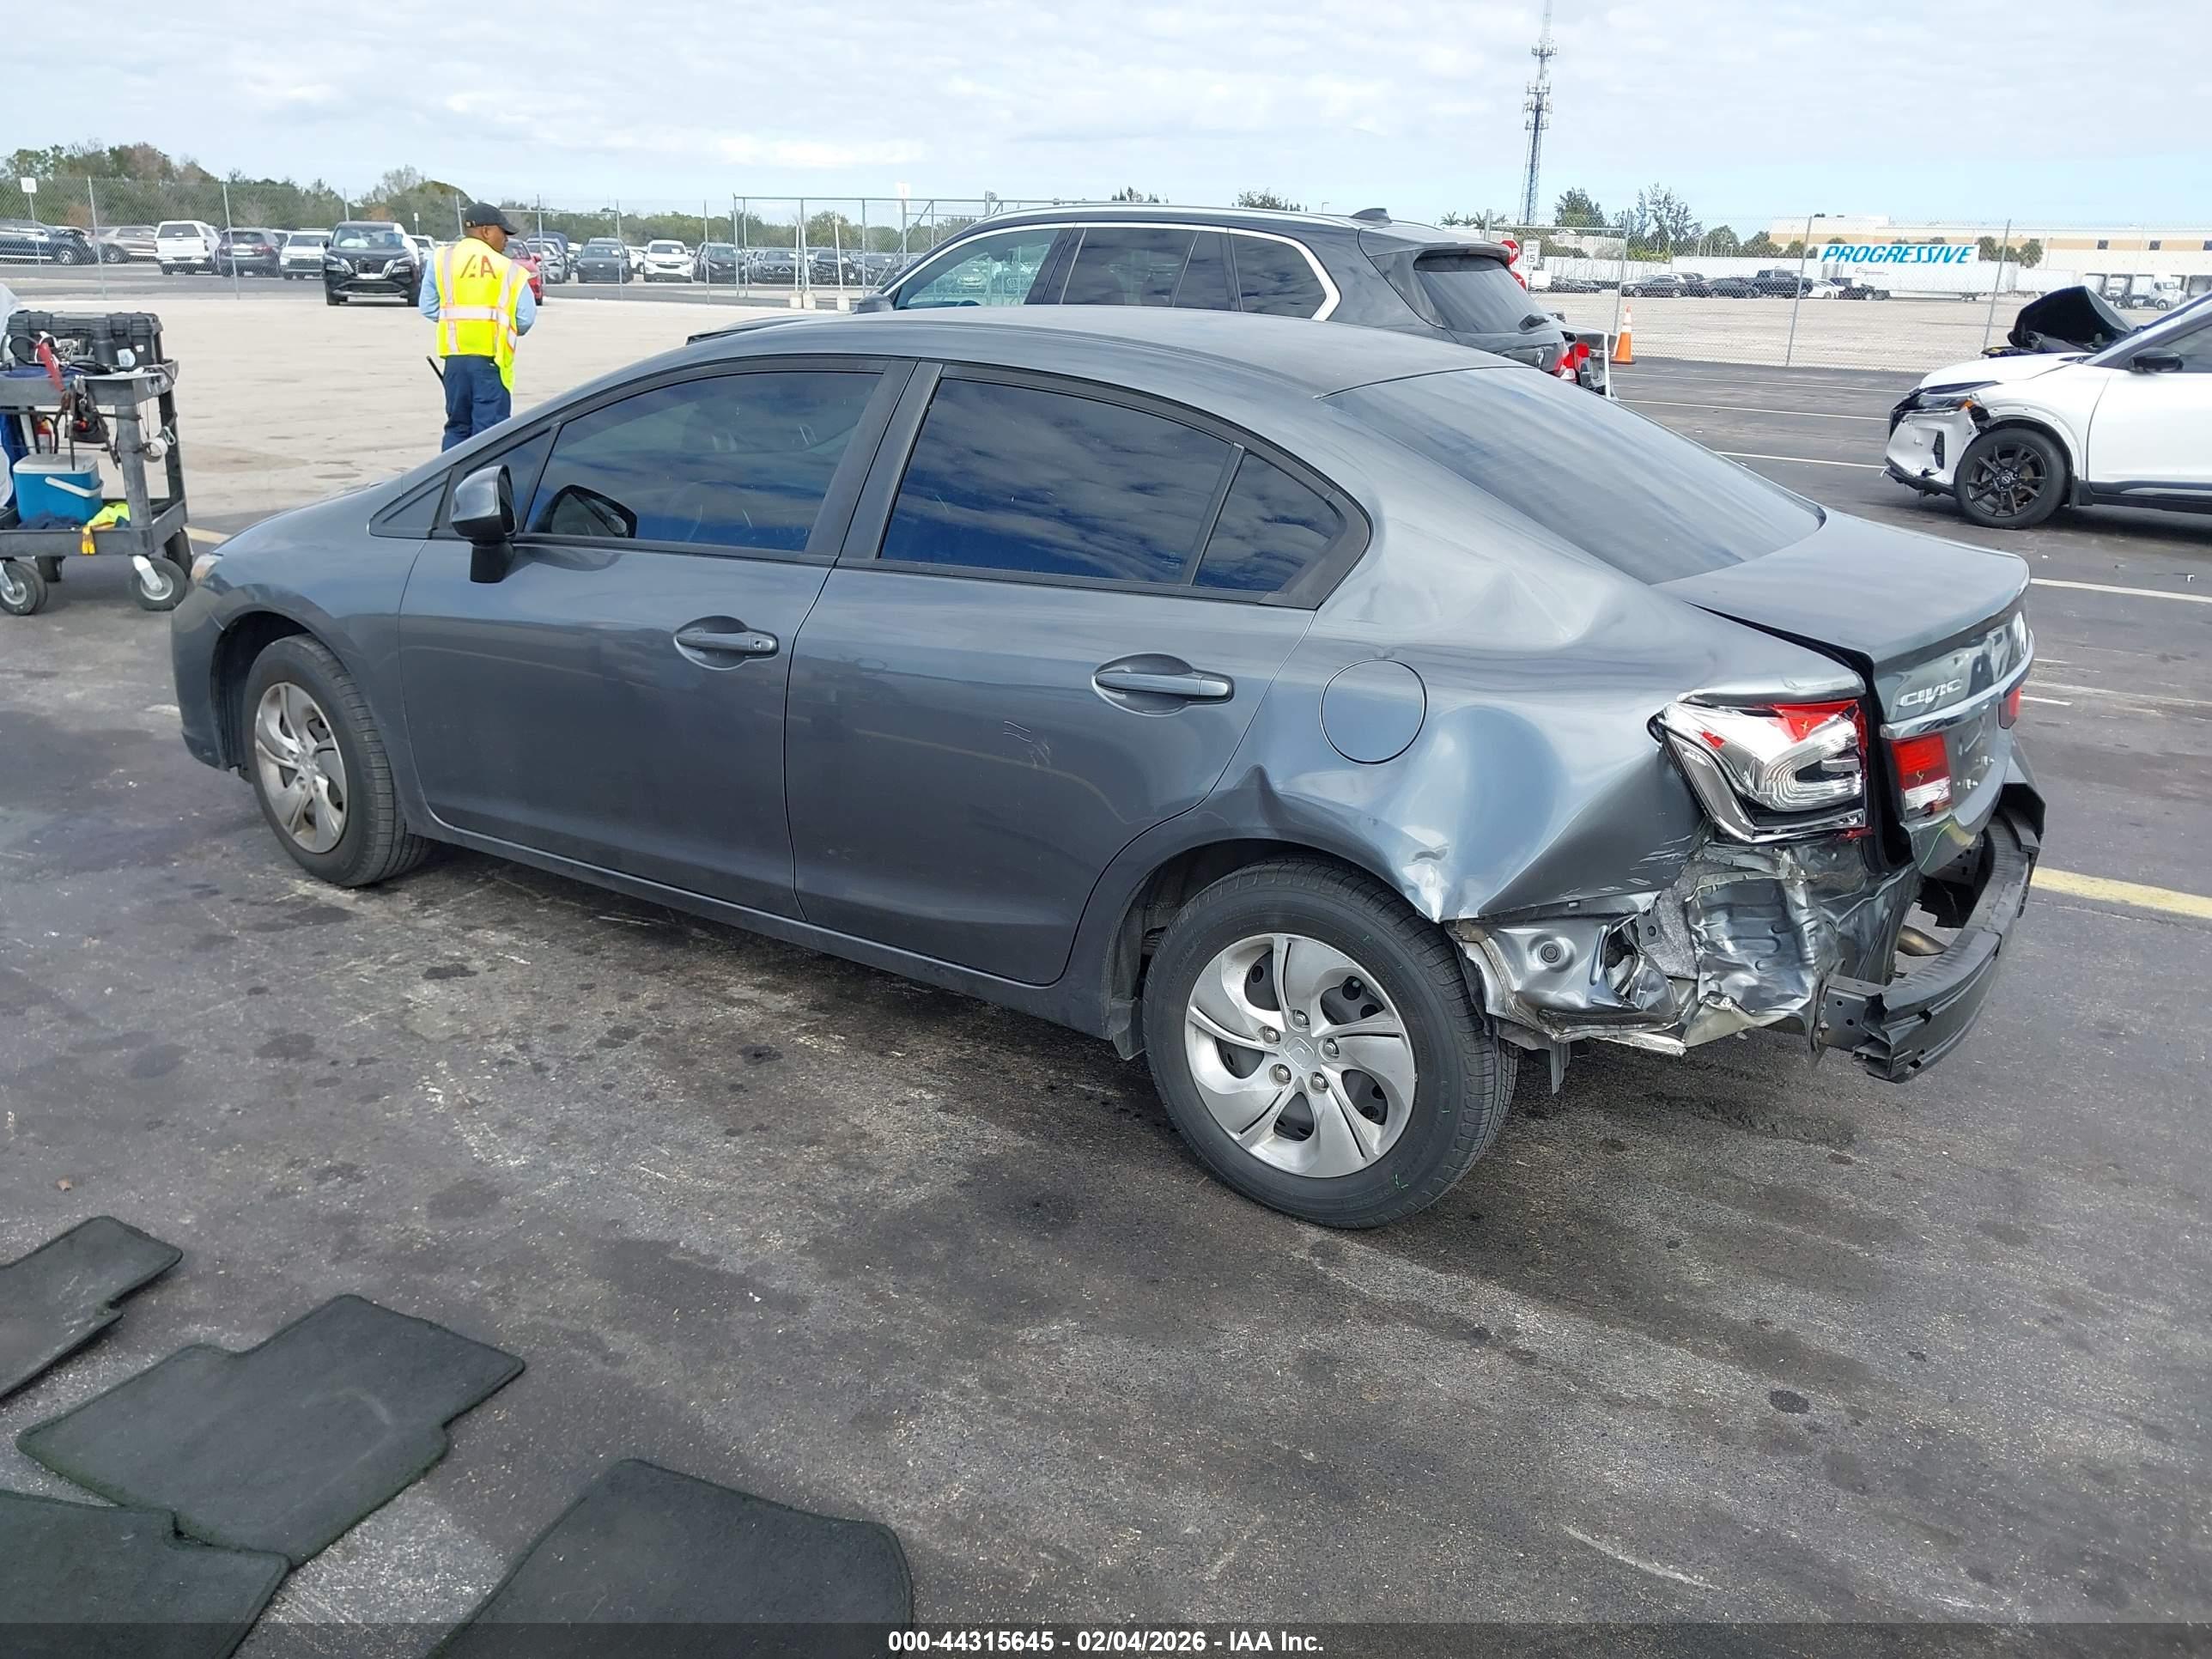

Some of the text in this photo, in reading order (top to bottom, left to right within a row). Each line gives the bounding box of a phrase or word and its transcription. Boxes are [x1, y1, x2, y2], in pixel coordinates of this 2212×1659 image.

[1526, 254, 1535, 263] 15
[1820, 246, 1975, 264] PROGRESSIVE
[1899, 678, 1962, 707] CIVIC
